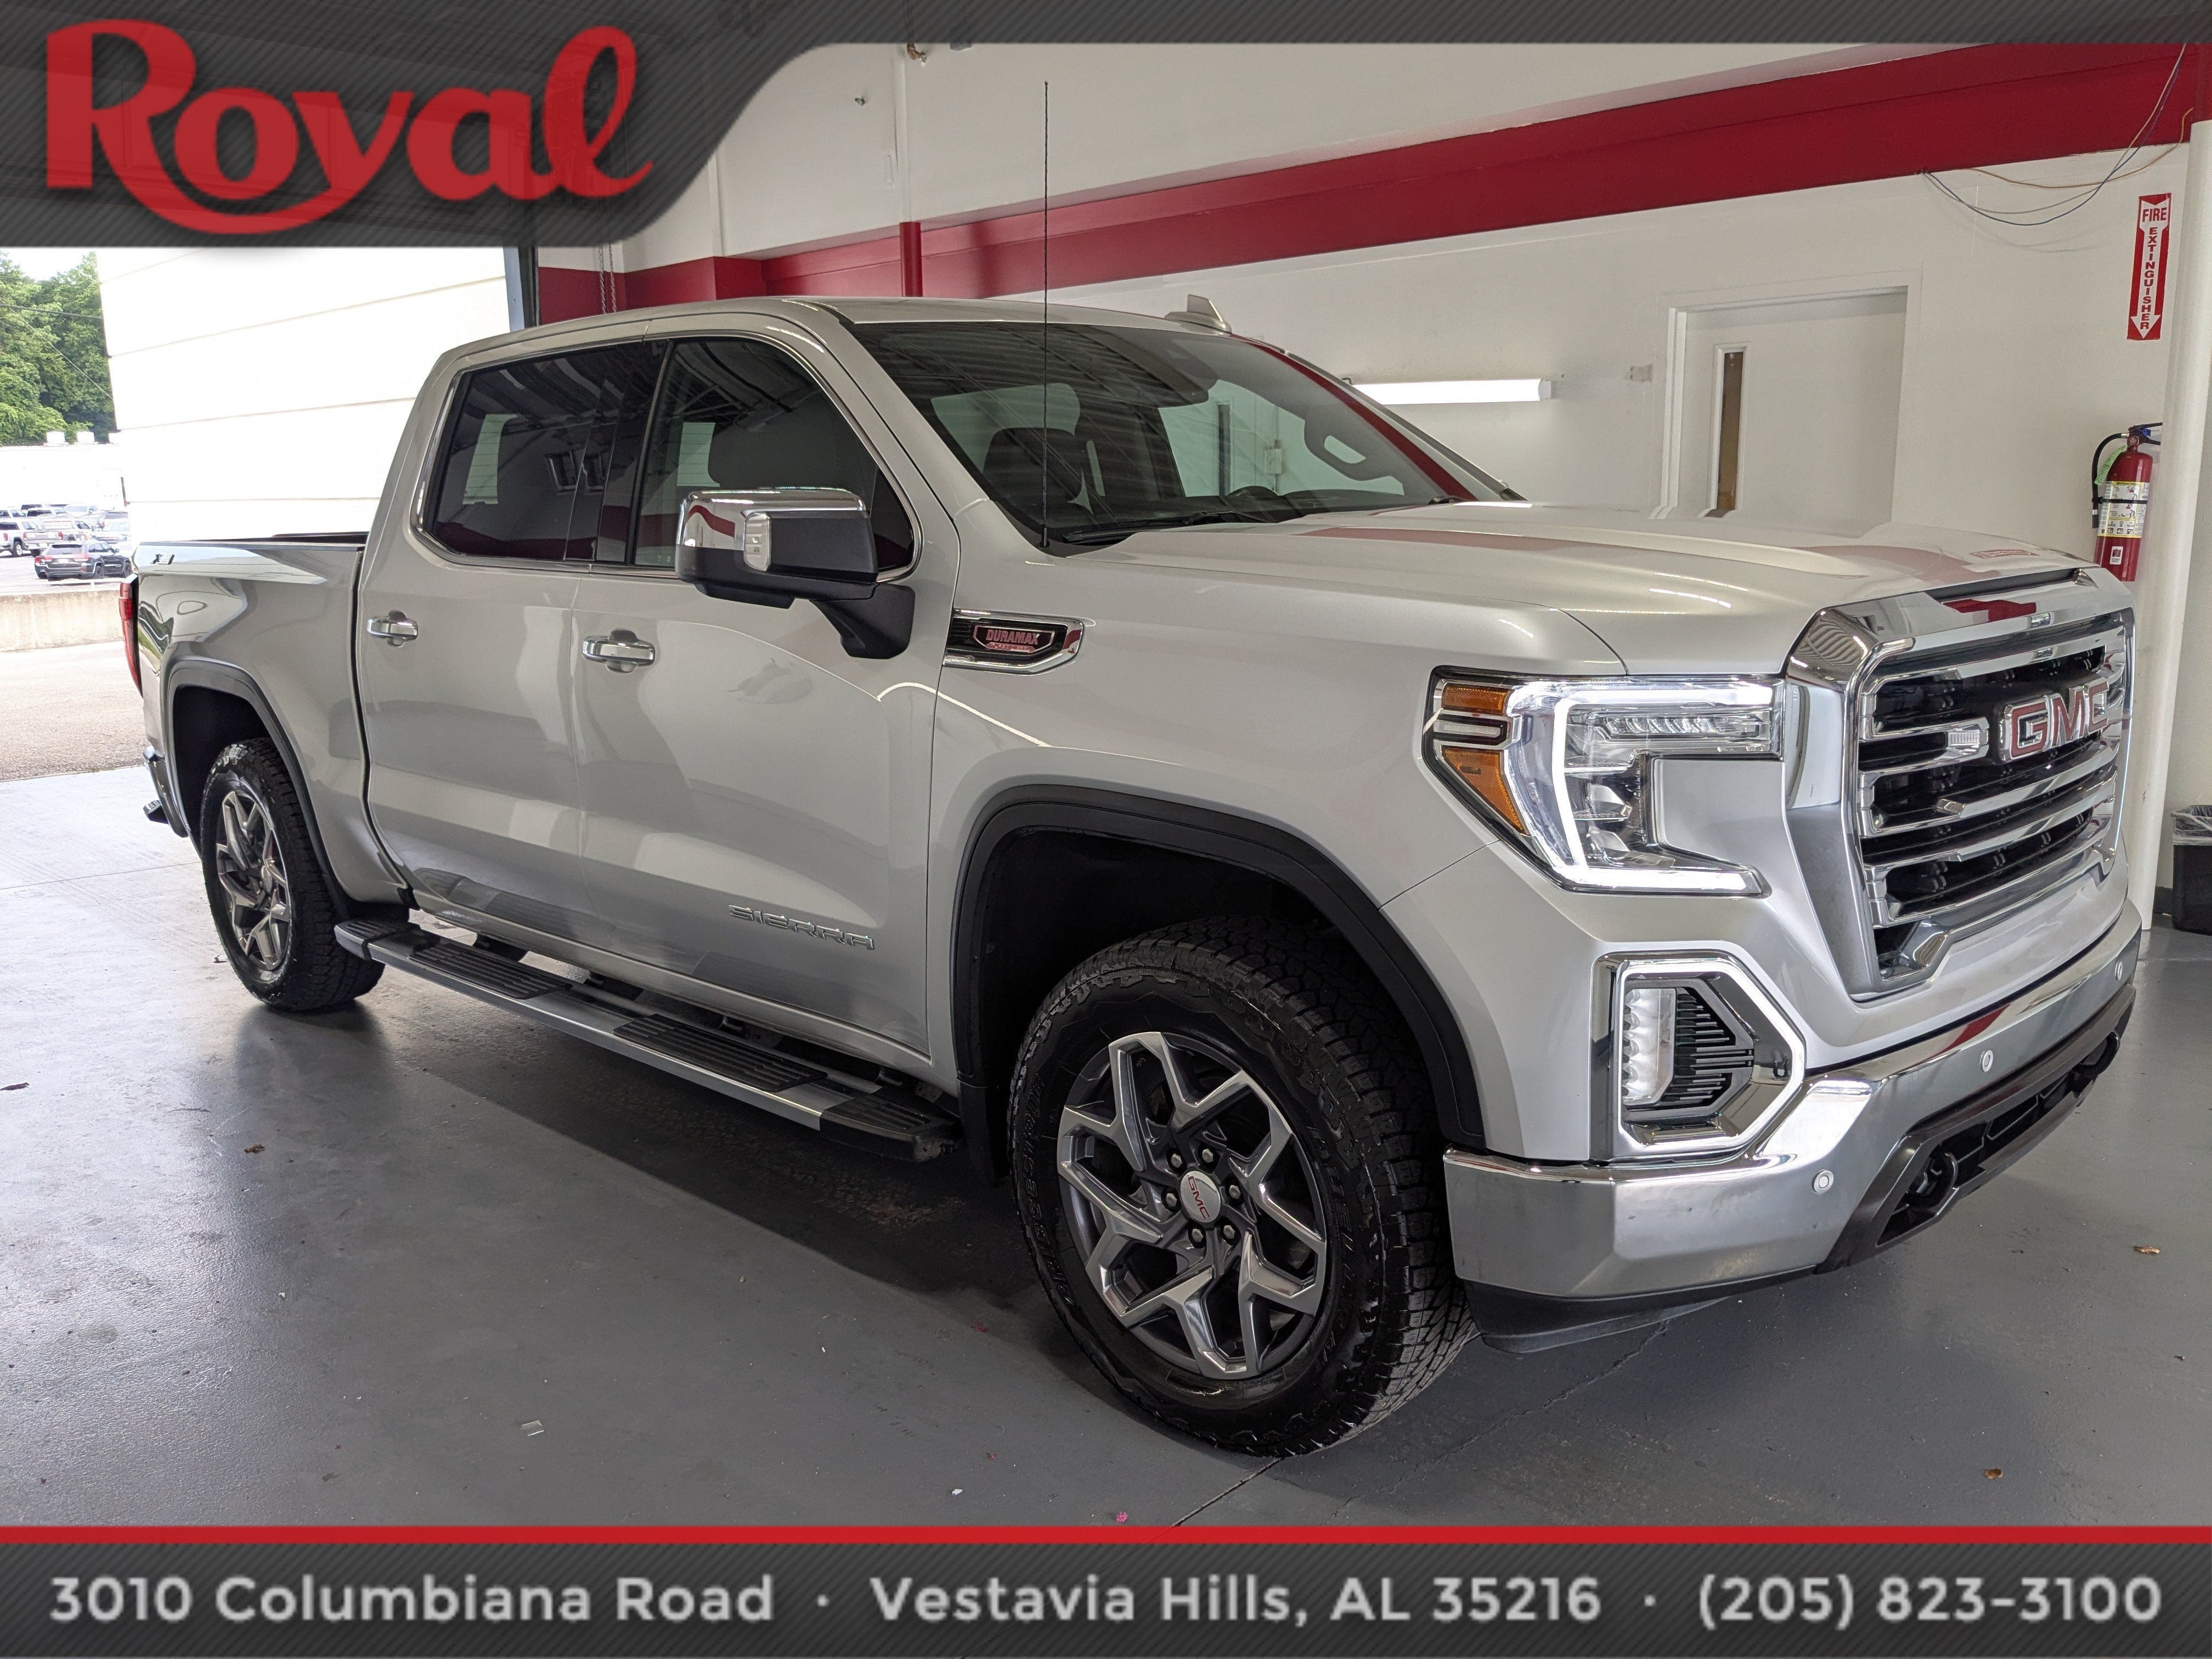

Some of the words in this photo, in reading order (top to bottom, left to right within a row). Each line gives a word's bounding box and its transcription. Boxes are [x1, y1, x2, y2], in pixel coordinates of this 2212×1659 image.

[2142, 207, 2167, 222] FIRE
[2140, 227, 2158, 330] EXTINGUISHER
[986, 629, 1040, 645] DURAMAX
[2002, 678, 2109, 761] GMC
[729, 905, 874, 950] SIERRA
[1188, 1176, 1210, 1219] GMC
